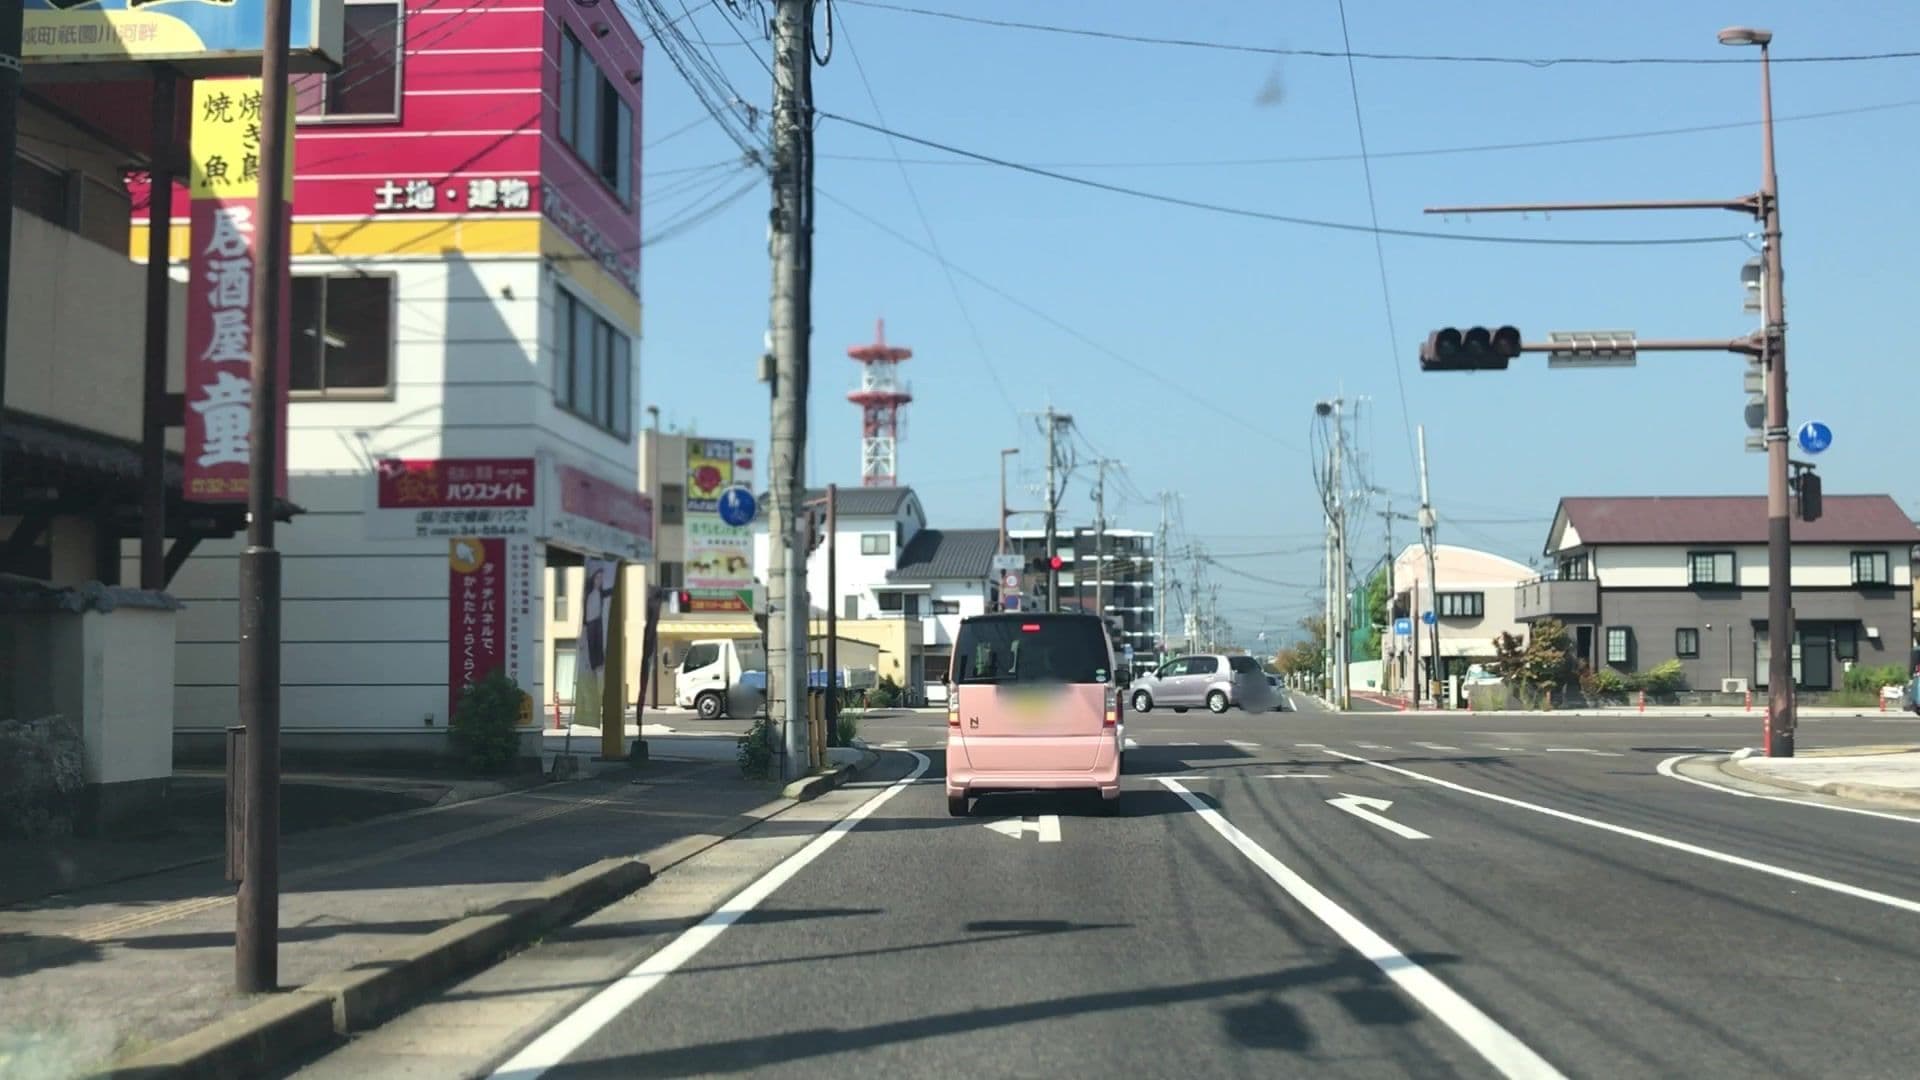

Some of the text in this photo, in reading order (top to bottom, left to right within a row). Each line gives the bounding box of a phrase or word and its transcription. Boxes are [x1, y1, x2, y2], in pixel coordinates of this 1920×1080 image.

[374, 179, 530, 210] 土地・建物
[202, 205, 255, 362] 居酒屋
[446, 482, 529, 501] ハウスメイト
